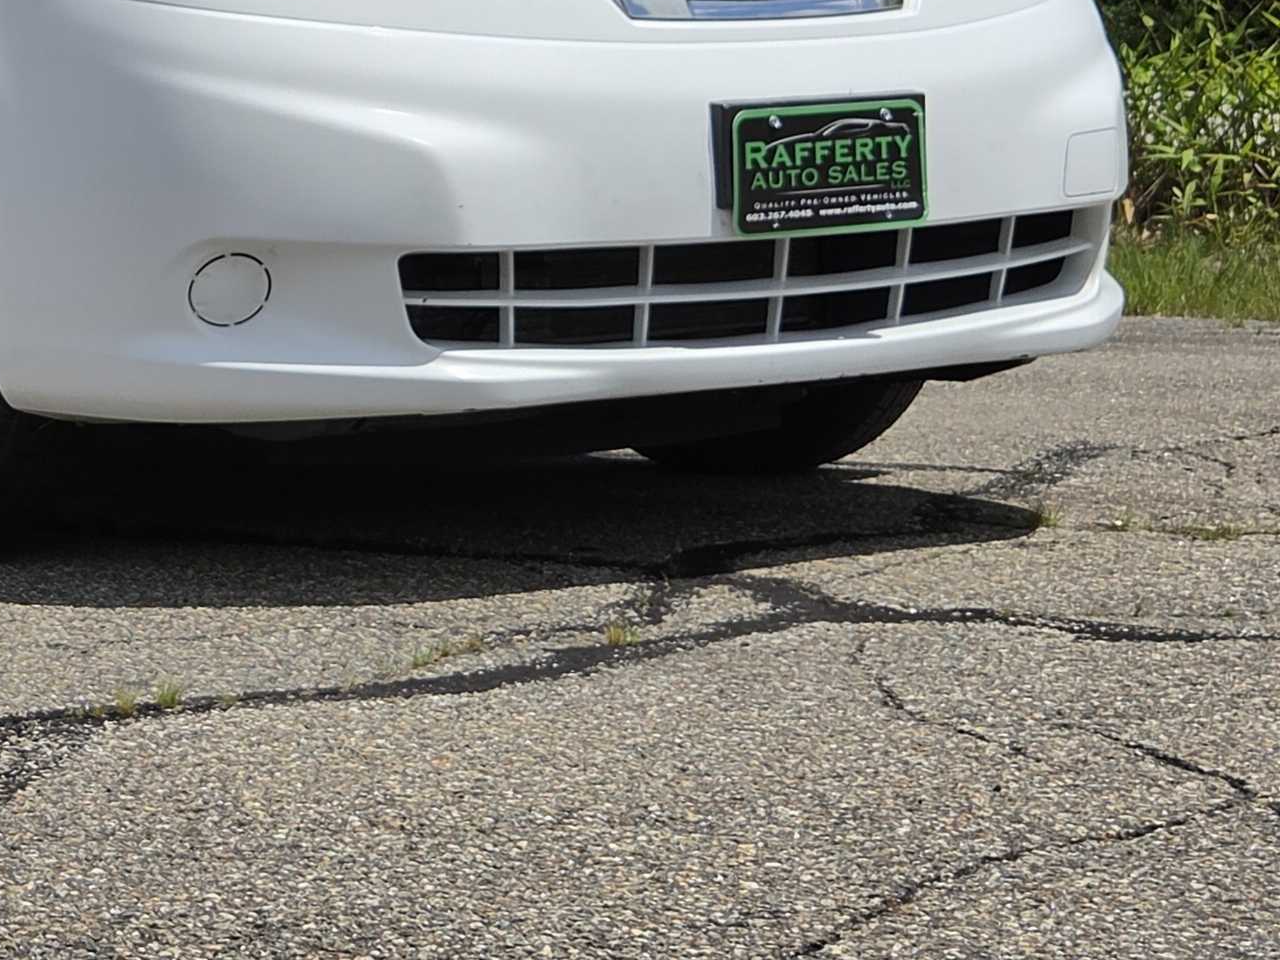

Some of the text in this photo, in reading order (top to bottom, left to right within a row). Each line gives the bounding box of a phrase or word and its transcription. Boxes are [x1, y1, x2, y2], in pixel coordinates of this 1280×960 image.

[744, 134, 913, 170] RAFFERTY
[751, 160, 907, 190] AUTO SALES
[861, 191, 910, 202] VEHICLES
